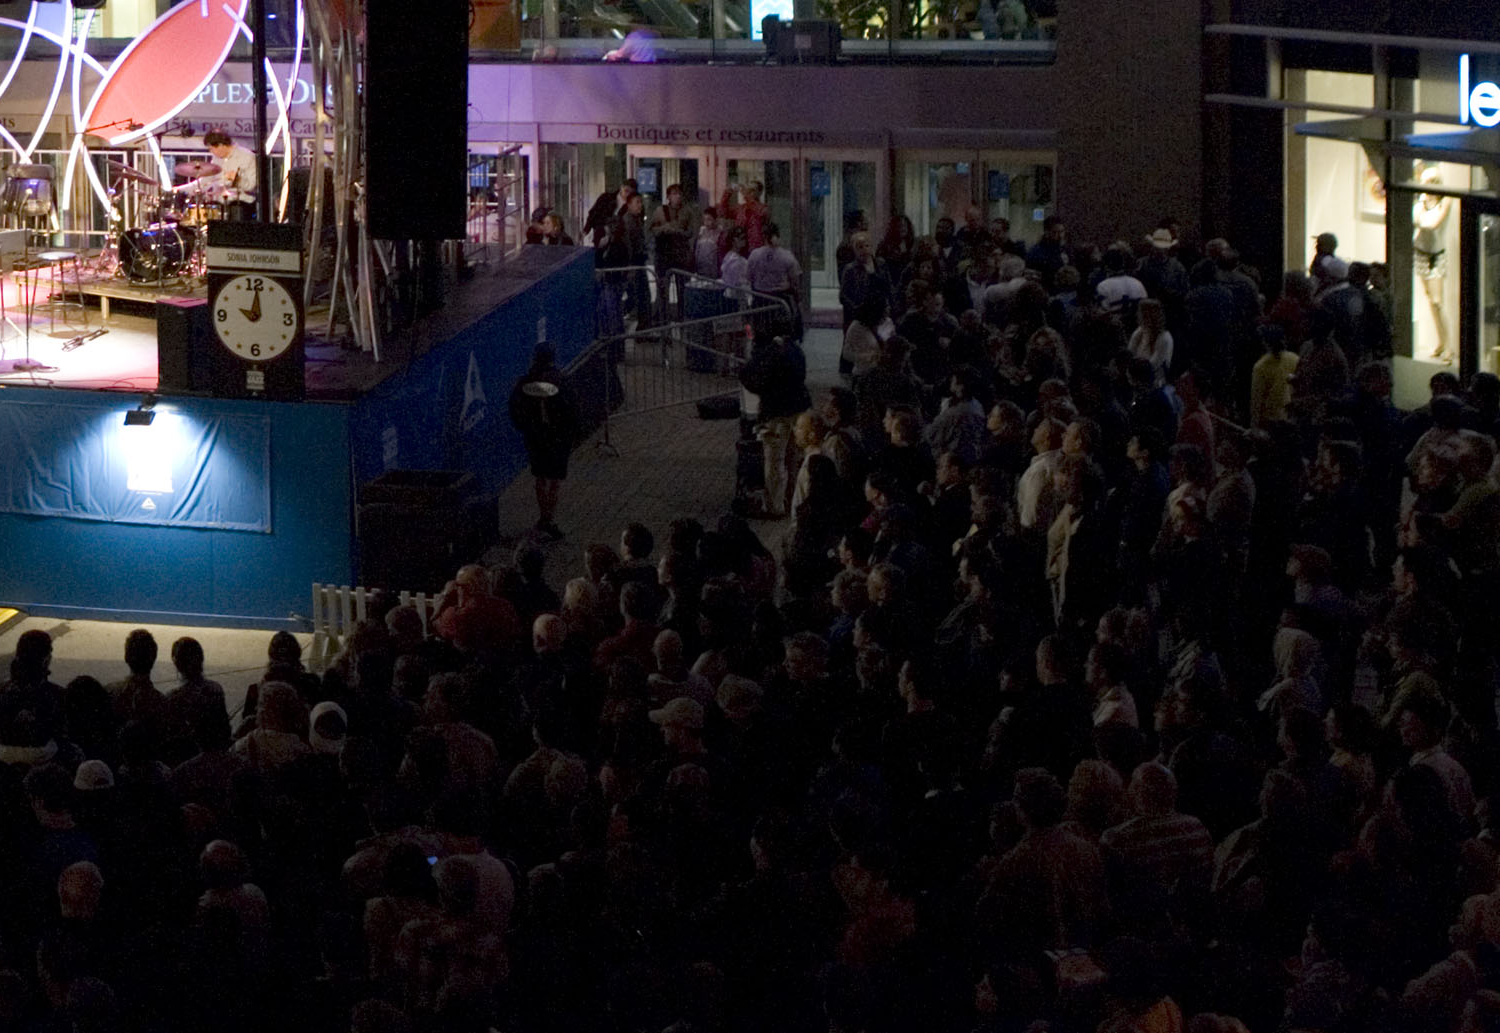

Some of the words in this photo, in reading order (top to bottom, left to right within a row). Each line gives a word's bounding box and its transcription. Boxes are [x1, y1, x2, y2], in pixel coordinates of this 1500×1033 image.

[596, 124, 690, 145] Boutiques
[696, 127, 713, 142] et
[720, 128, 825, 143] restaurants
[227, 252, 248, 263] SONIA
[249, 253, 280, 264] JOHNSON
[245, 278, 264, 292] 12
[217, 309, 228, 322] 9
[283, 313, 294, 326] 3
[250, 343, 261, 356] 6
